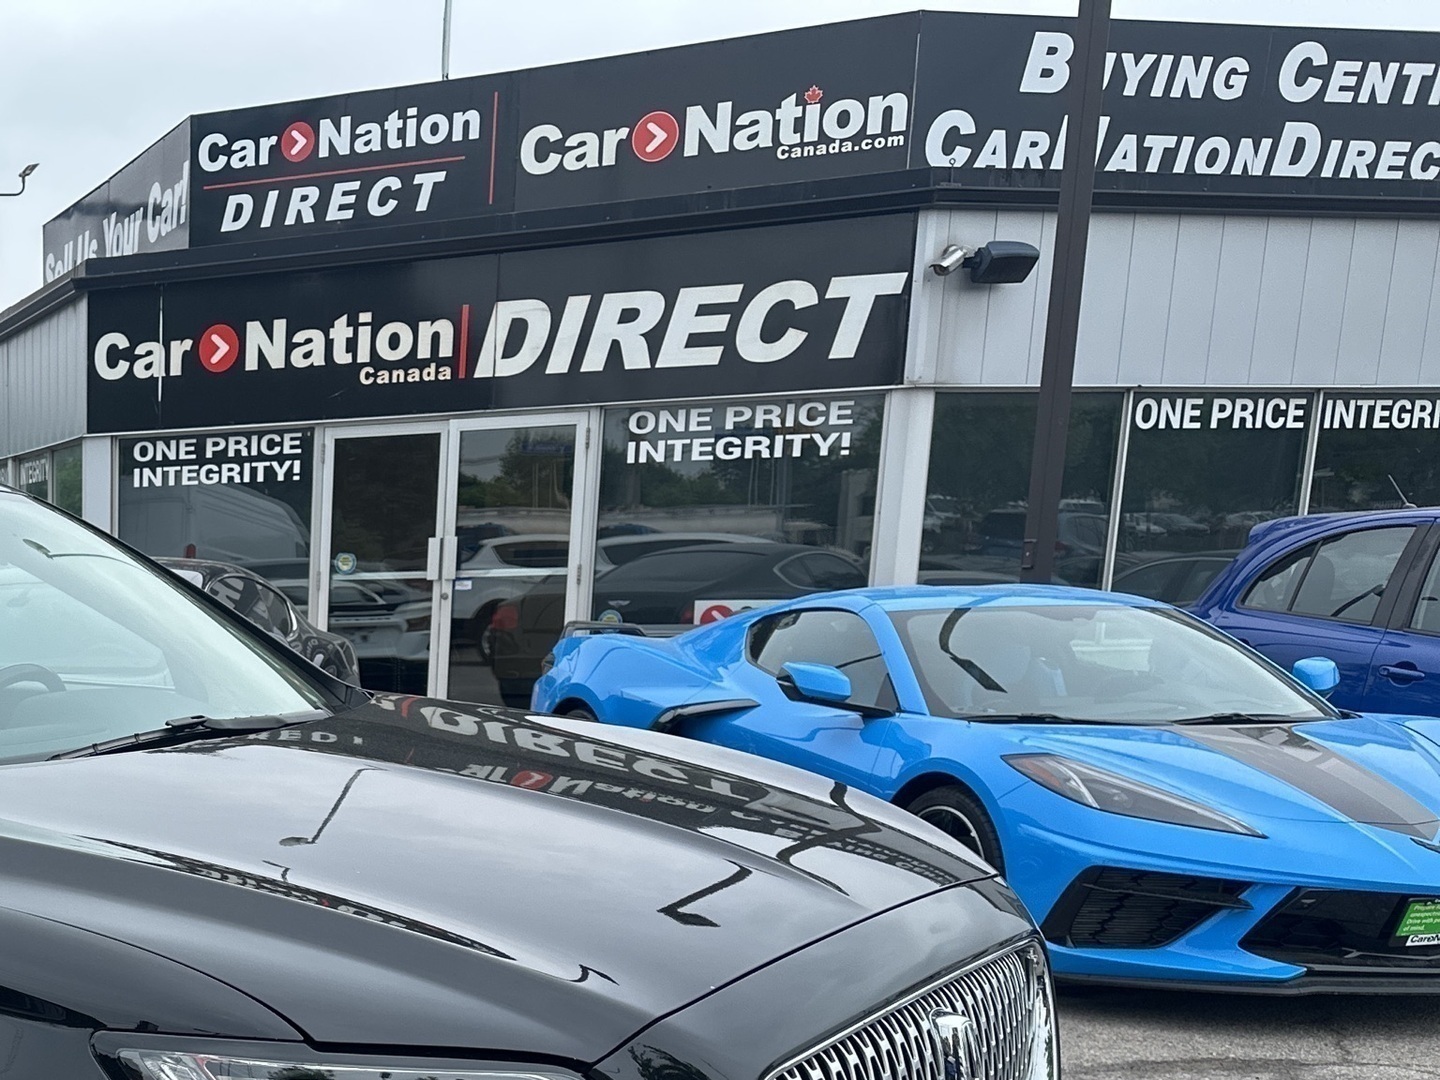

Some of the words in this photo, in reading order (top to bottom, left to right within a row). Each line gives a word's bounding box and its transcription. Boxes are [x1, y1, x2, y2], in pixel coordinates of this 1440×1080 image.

[1019, 31, 1250, 100] BYING
[1278, 41, 1440, 105] CENT
[198, 132, 278, 173] Car
[318, 107, 481, 159] Nation
[521, 124, 629, 175] Car
[683, 88, 908, 157] Nation
[776, 133, 905, 160] Canada.com
[103, 207, 143, 257] Your
[147, 159, 189, 243] Car!
[219, 171, 447, 233] DIRECT
[94, 331, 193, 381] Car
[244, 312, 454, 372] Nation
[472, 272, 908, 379] DIRECT
[359, 362, 452, 386] Canada
[628, 407, 713, 434] ONE
[724, 400, 855, 430] PRICE
[1134, 398, 1203, 429] ONE
[1210, 398, 1307, 429] PRICE
[133, 439, 197, 462] ONE
[205, 432, 302, 458] PRICE
[626, 432, 851, 464] INTEGRITY!
[133, 460, 301, 488] INTEGRITY!
